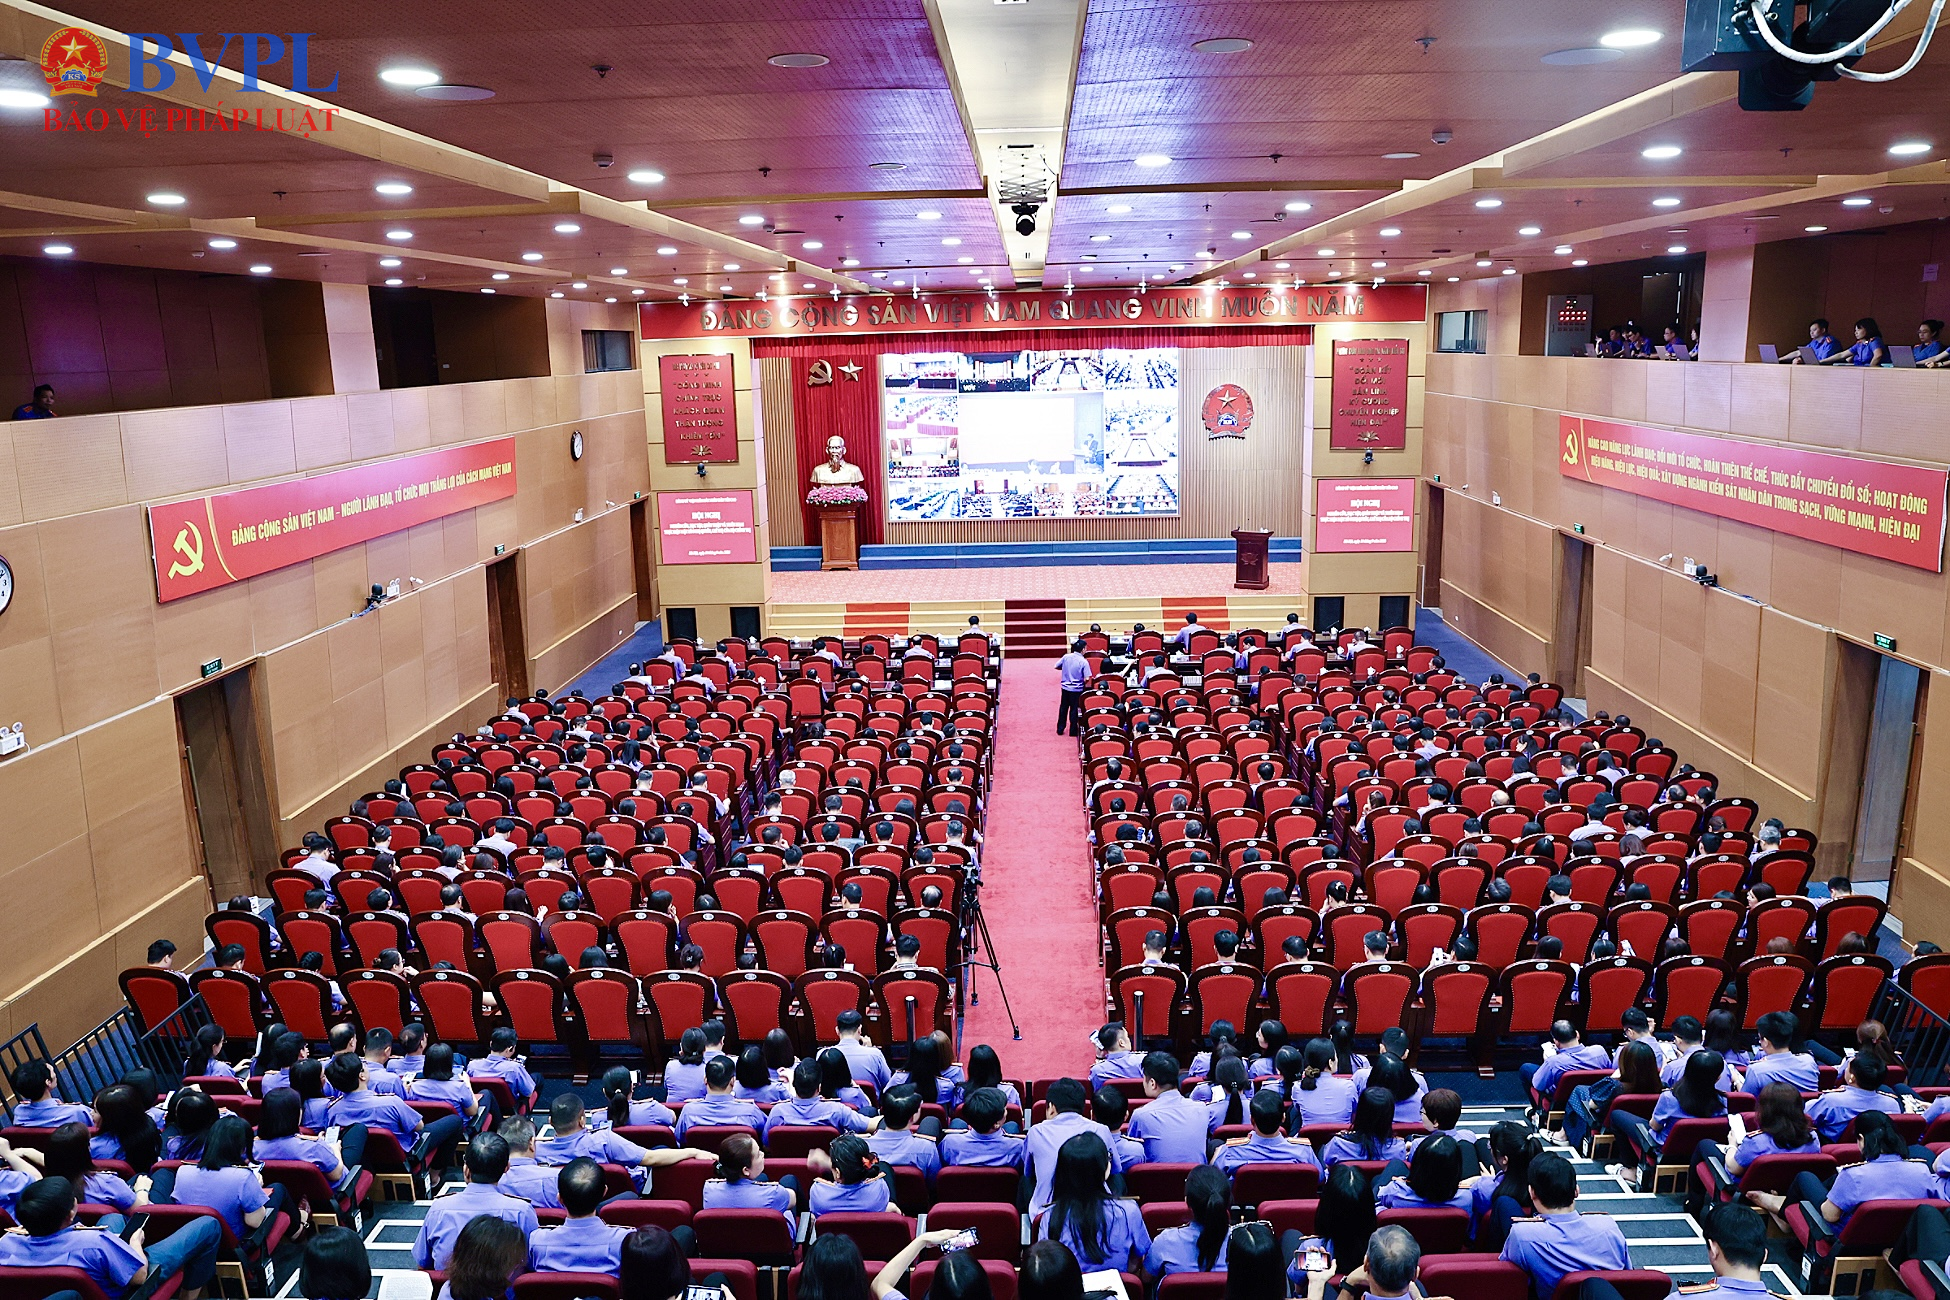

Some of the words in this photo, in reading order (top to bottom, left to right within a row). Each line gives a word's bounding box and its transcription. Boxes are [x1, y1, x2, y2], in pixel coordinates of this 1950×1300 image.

[701, 303, 773, 331] ĐẢNG
[779, 299, 859, 332] CỘNG
[867, 297, 917, 325] SẢN
[922, 297, 973, 328] VIỆT
[982, 299, 1040, 323] NAM
[1048, 297, 1143, 321] QUANG
[1150, 296, 1212, 319] VINH
[1220, 290, 1298, 317] MUÔN
[1307, 289, 1365, 316] NĂM
[1688, 474, 1708, 493] NGÀNH
[1709, 477, 1724, 496] KIỂM
[1725, 481, 1737, 498] SÁT
[1738, 484, 1757, 502] NHÂN
[1758, 490, 1773, 507] DÂN
[1774, 495, 1797, 513] TRONG
[1799, 500, 1822, 520] SẠCH,
[1824, 504, 1846, 524] VỮNG
[1848, 511, 1876, 533] MẠNH,
[1879, 516, 1901, 538] HIỆN
[1903, 523, 1920, 544] ĐẠI
[1703, 457, 1720, 474] HOÀN
[1721, 461, 1739, 480] THIỆN
[1741, 462, 1753, 481] THỂ
[1754, 466, 1769, 487] CHẾ,
[1771, 470, 1789, 487] THÚC
[1791, 470, 1805, 490] ĐẨY
[1807, 476, 1838, 498] CHUYỂN
[1840, 480, 1855, 501] ĐỔI
[1857, 483, 1871, 506] SỐ;
[1874, 490, 1898, 511] HOẠT
[1900, 492, 1928, 515] ĐỘNG
[231, 523, 257, 546] ĐẢNG
[258, 519, 281, 541] CỘNG
[282, 512, 299, 533] SẢN
[300, 509, 316, 530] VIỆT
[317, 506, 334, 523] NAM
[341, 496, 362, 517] NGƯỜI
[362, 492, 379, 512] LÃNH
[380, 491, 395, 508] ĐẠO,
